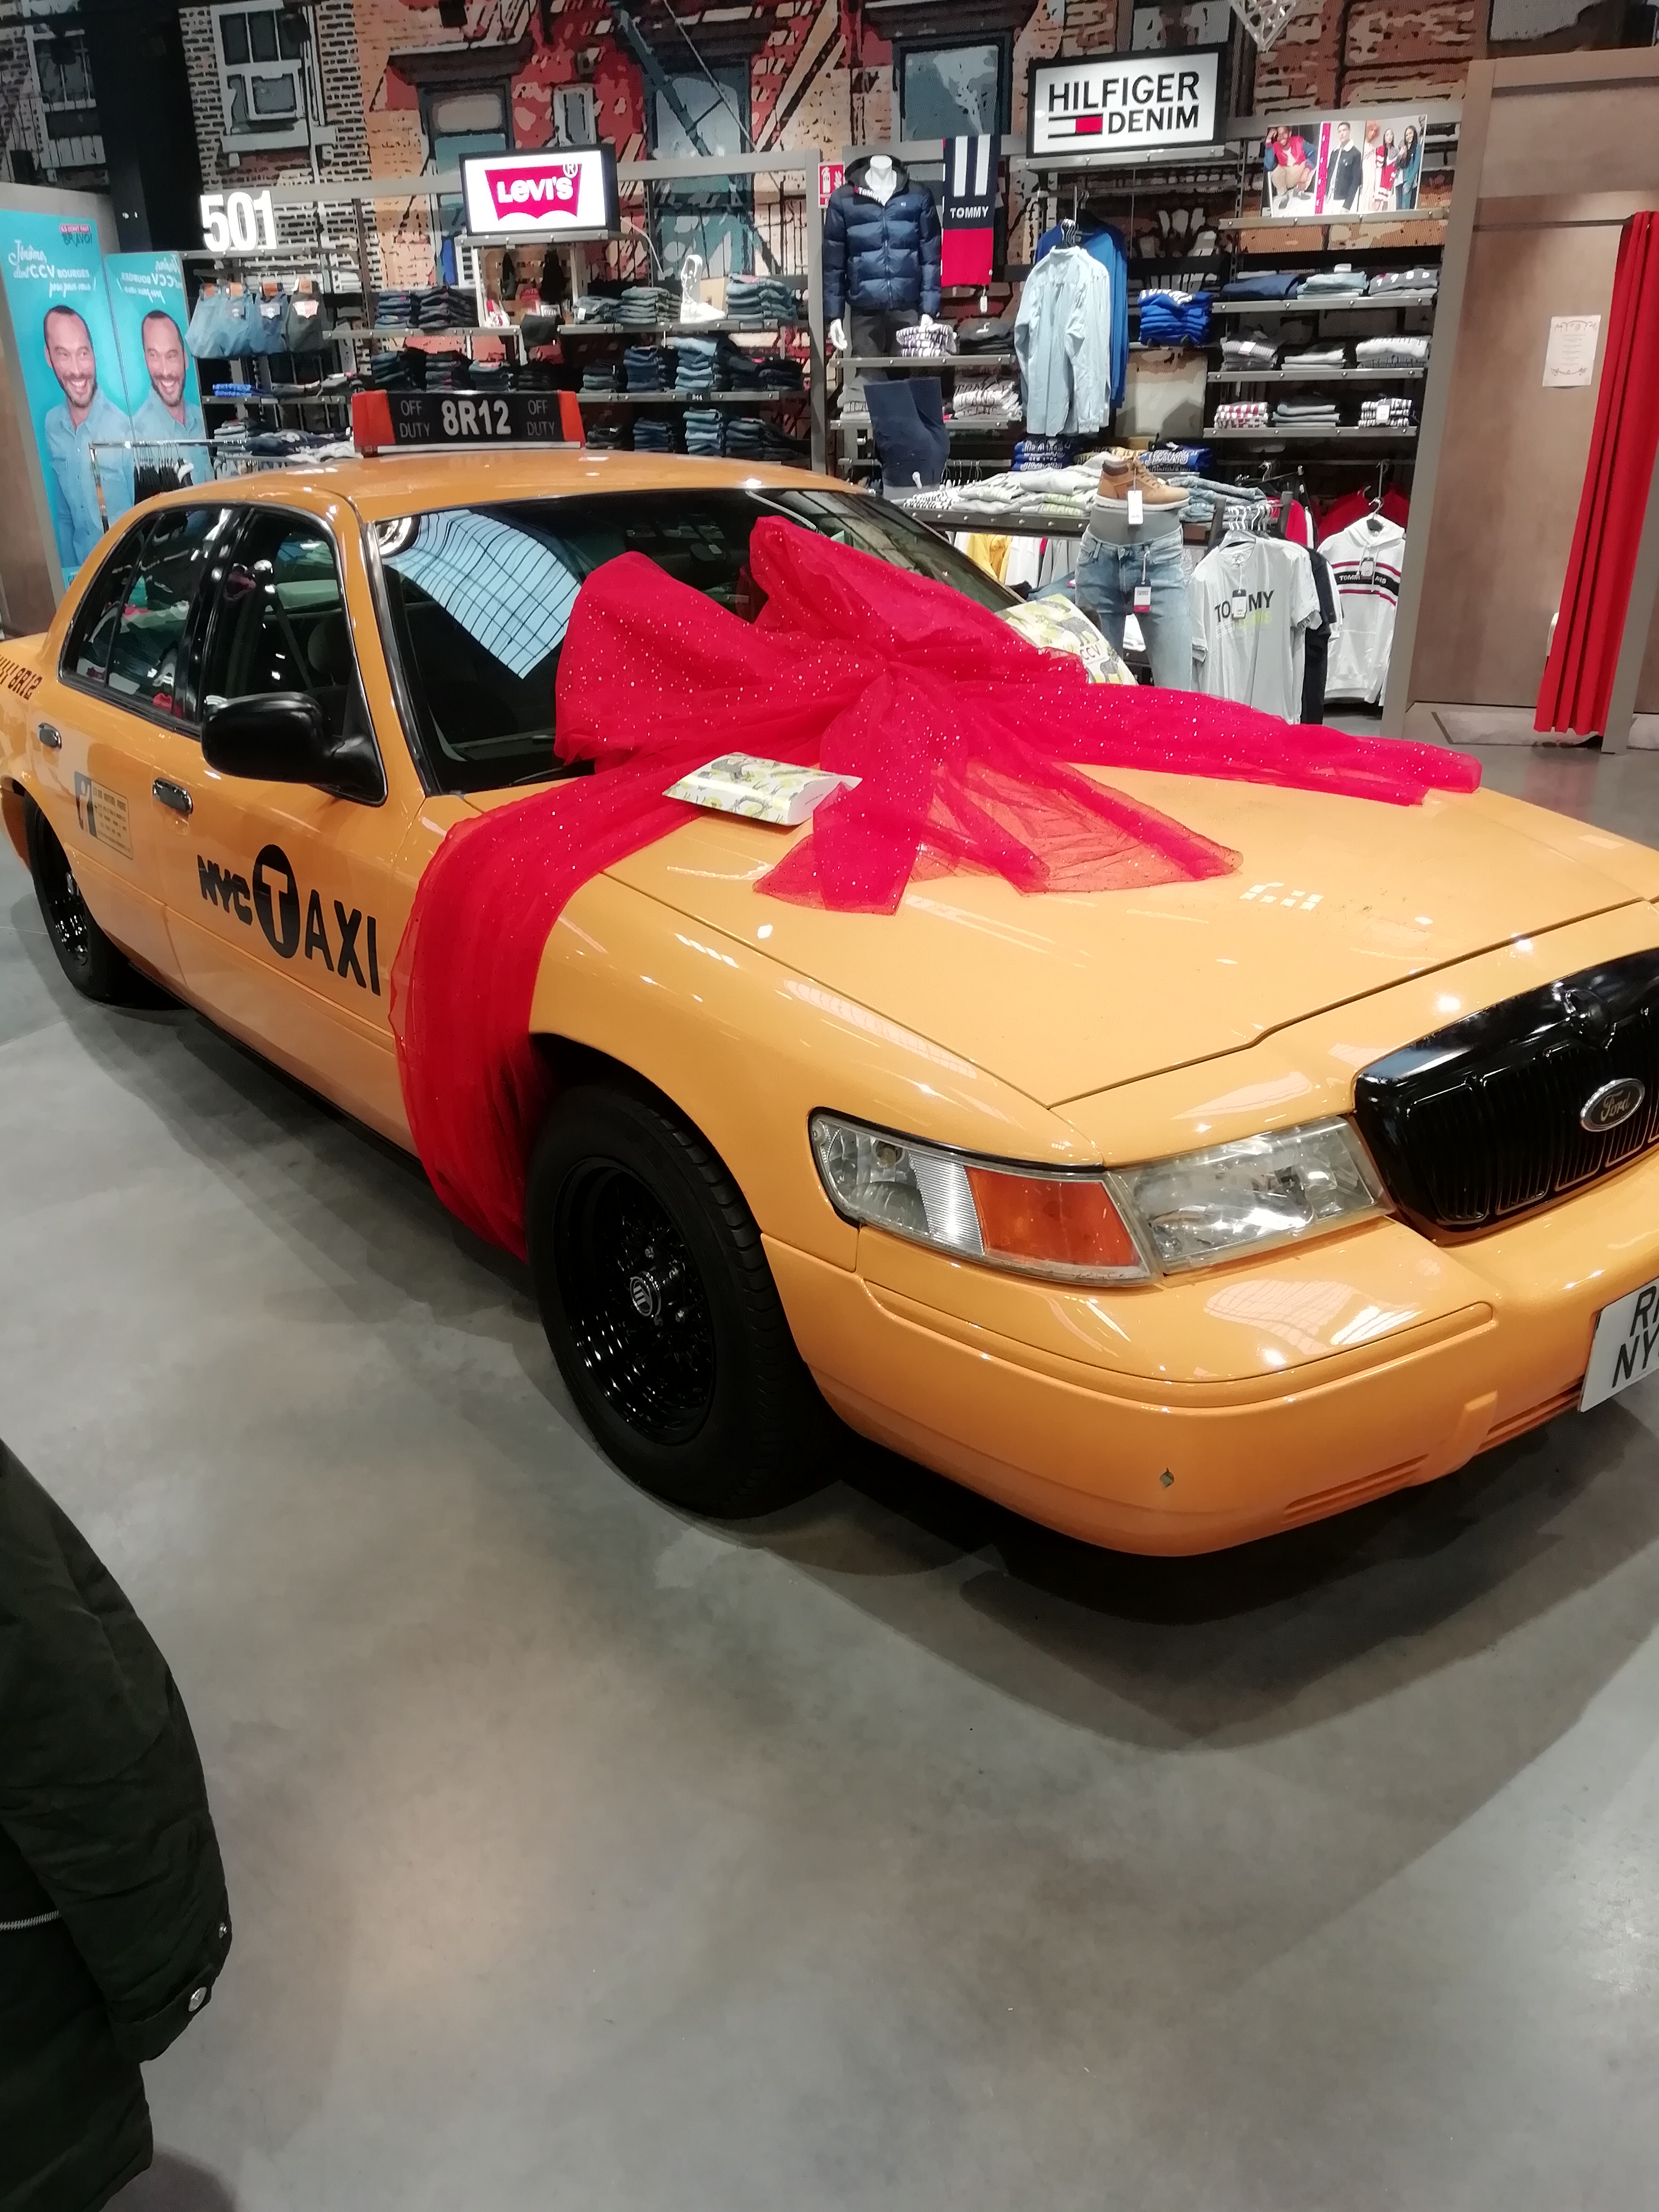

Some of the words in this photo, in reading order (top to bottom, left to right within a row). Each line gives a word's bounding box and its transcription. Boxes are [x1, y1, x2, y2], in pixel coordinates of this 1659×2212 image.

[1048, 71, 1200, 112] HILFIGER
[1108, 104, 1200, 135] DENIM
[200, 190, 277, 252] 501
[950, 206, 989, 219] TOMMY
[30, 265, 55, 278] CCV
[400, 400, 422, 416] OFF
[441, 399, 512, 436] 8R12
[528, 399, 548, 415] OFF
[399, 422, 430, 438] DUTY
[527, 421, 554, 437] DUTY
[1214, 589, 1275, 623] TOMY
[1079, 644, 1101, 660] CCV
[8, 668, 43, 700] 8R12
[197, 854, 253, 926] NYC
[262, 862, 381, 996] TAXI
[1600, 1089, 1631, 1122] Ford
